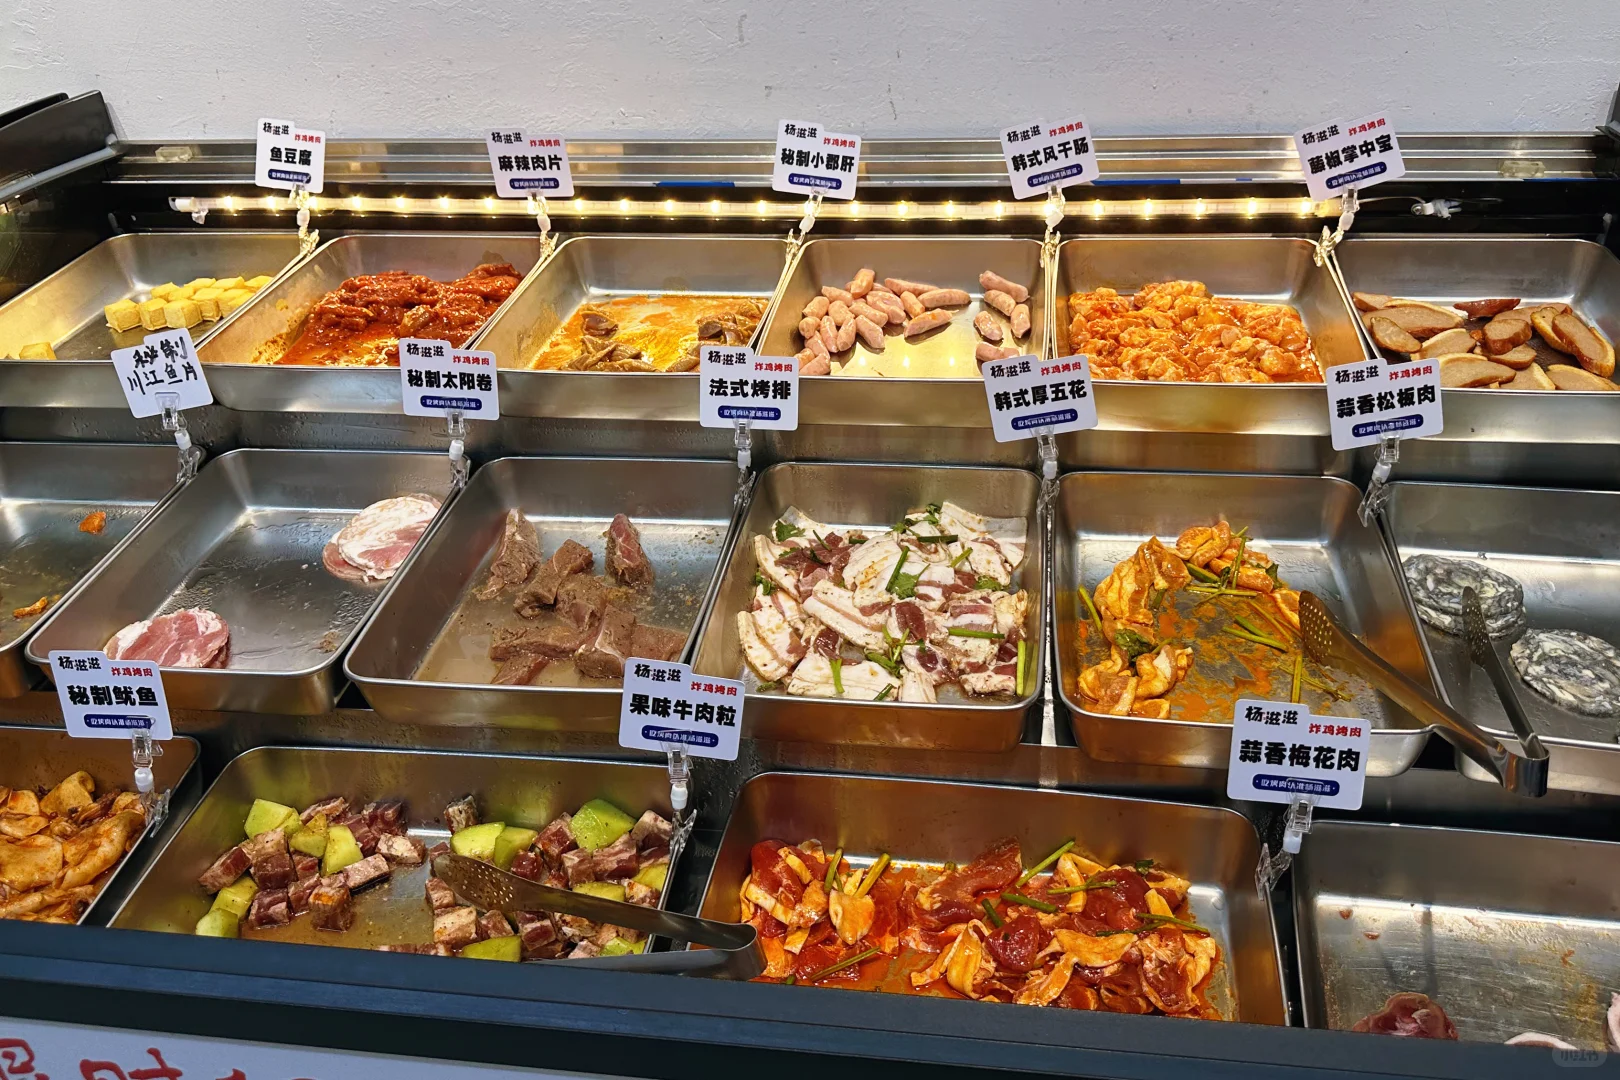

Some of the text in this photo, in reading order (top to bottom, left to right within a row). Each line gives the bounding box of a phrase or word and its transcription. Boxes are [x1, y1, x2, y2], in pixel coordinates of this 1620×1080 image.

[263, 122, 289, 135] 杨滋滋
[785, 124, 817, 138] 杨滋滋
[1007, 125, 1041, 143] 杨滋滋
[1049, 122, 1083, 137] 炸鸡烤肉
[1302, 125, 1339, 145] 杨滋滋
[1348, 118, 1386, 136] 炸鸡烤肉
[491, 132, 523, 144] 杨滋滋
[823, 137, 855, 148] 炸鸡烤肉
[270, 147, 312, 166] 鱼豆腐
[498, 155, 562, 171] 麻辣肉片
[1011, 137, 1089, 172] 韩式风干肠
[1308, 134, 1393, 174] 藤椒掌中宝
[133, 336, 188, 368] 秘制
[407, 343, 444, 357] 杨滋滋
[708, 351, 746, 365] 杨滋滋
[453, 356, 489, 365] 炸鸡烤肉
[755, 362, 792, 372] 炸鸡烤肉
[990, 361, 1031, 378] 杨滋滋
[1041, 362, 1081, 376] 炸鸡烤肉
[127, 362, 197, 395] 川江鱼片
[407, 369, 492, 391] 秘制太阳卷
[1335, 365, 1379, 383] 杨滋滋
[1389, 366, 1432, 381] 炸鸡烤肉
[709, 378, 791, 399] 法式烤排
[994, 379, 1087, 411] 韩式厚五花
[1336, 384, 1435, 418] 蒜香松板肉
[58, 656, 101, 671] 杨滋滋
[111, 667, 153, 677] 炸鸡烤肉
[634, 664, 681, 682] 杨滋滋
[67, 685, 158, 706] 秘制鱿鱼
[691, 682, 737, 696] 炸鸡烤肉
[630, 693, 736, 727] 果味牛肉粒
[1245, 706, 1298, 725] 杨滋滋
[1309, 723, 1361, 737] 炸鸡烤肉
[1239, 739, 1360, 771] 蒜香梅花肉
